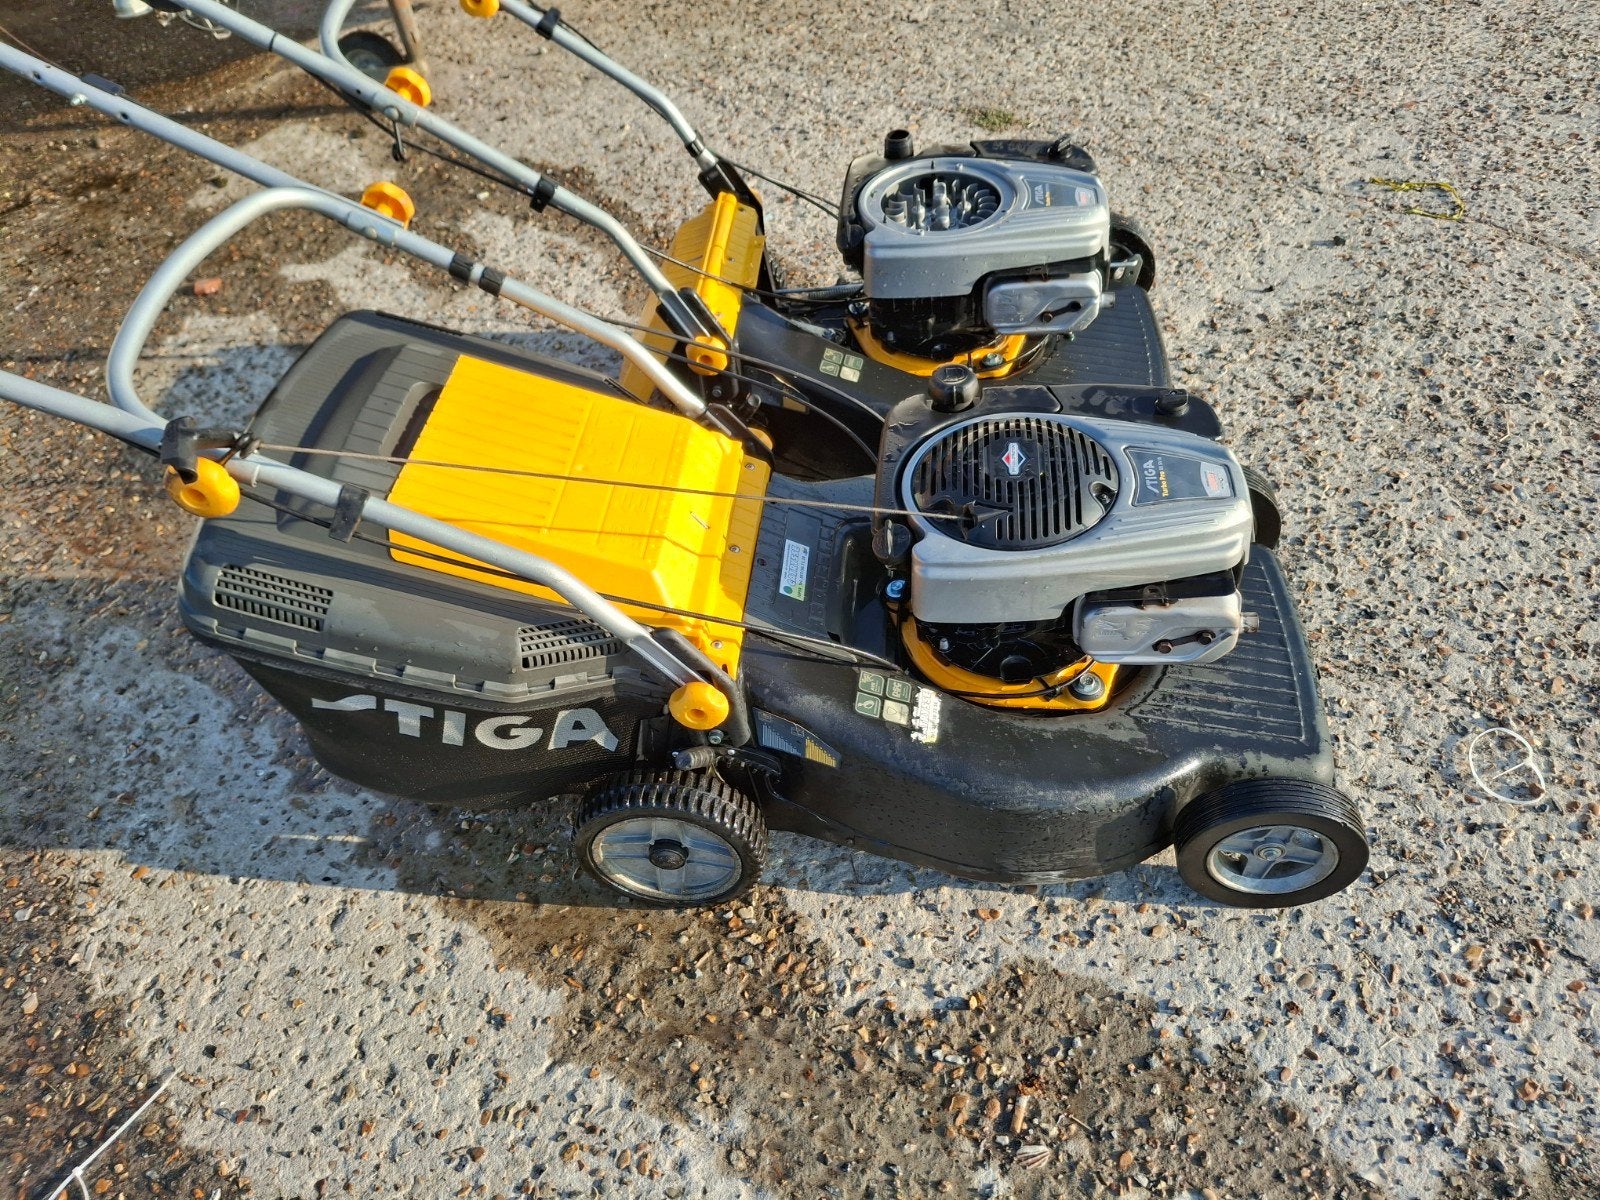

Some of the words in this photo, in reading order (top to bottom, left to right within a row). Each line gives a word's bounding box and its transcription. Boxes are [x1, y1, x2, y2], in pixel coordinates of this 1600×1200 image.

[1143, 460, 1160, 493] STIGA
[1161, 480, 1169, 497] Turbo
[311, 694, 619, 752] STIGA
